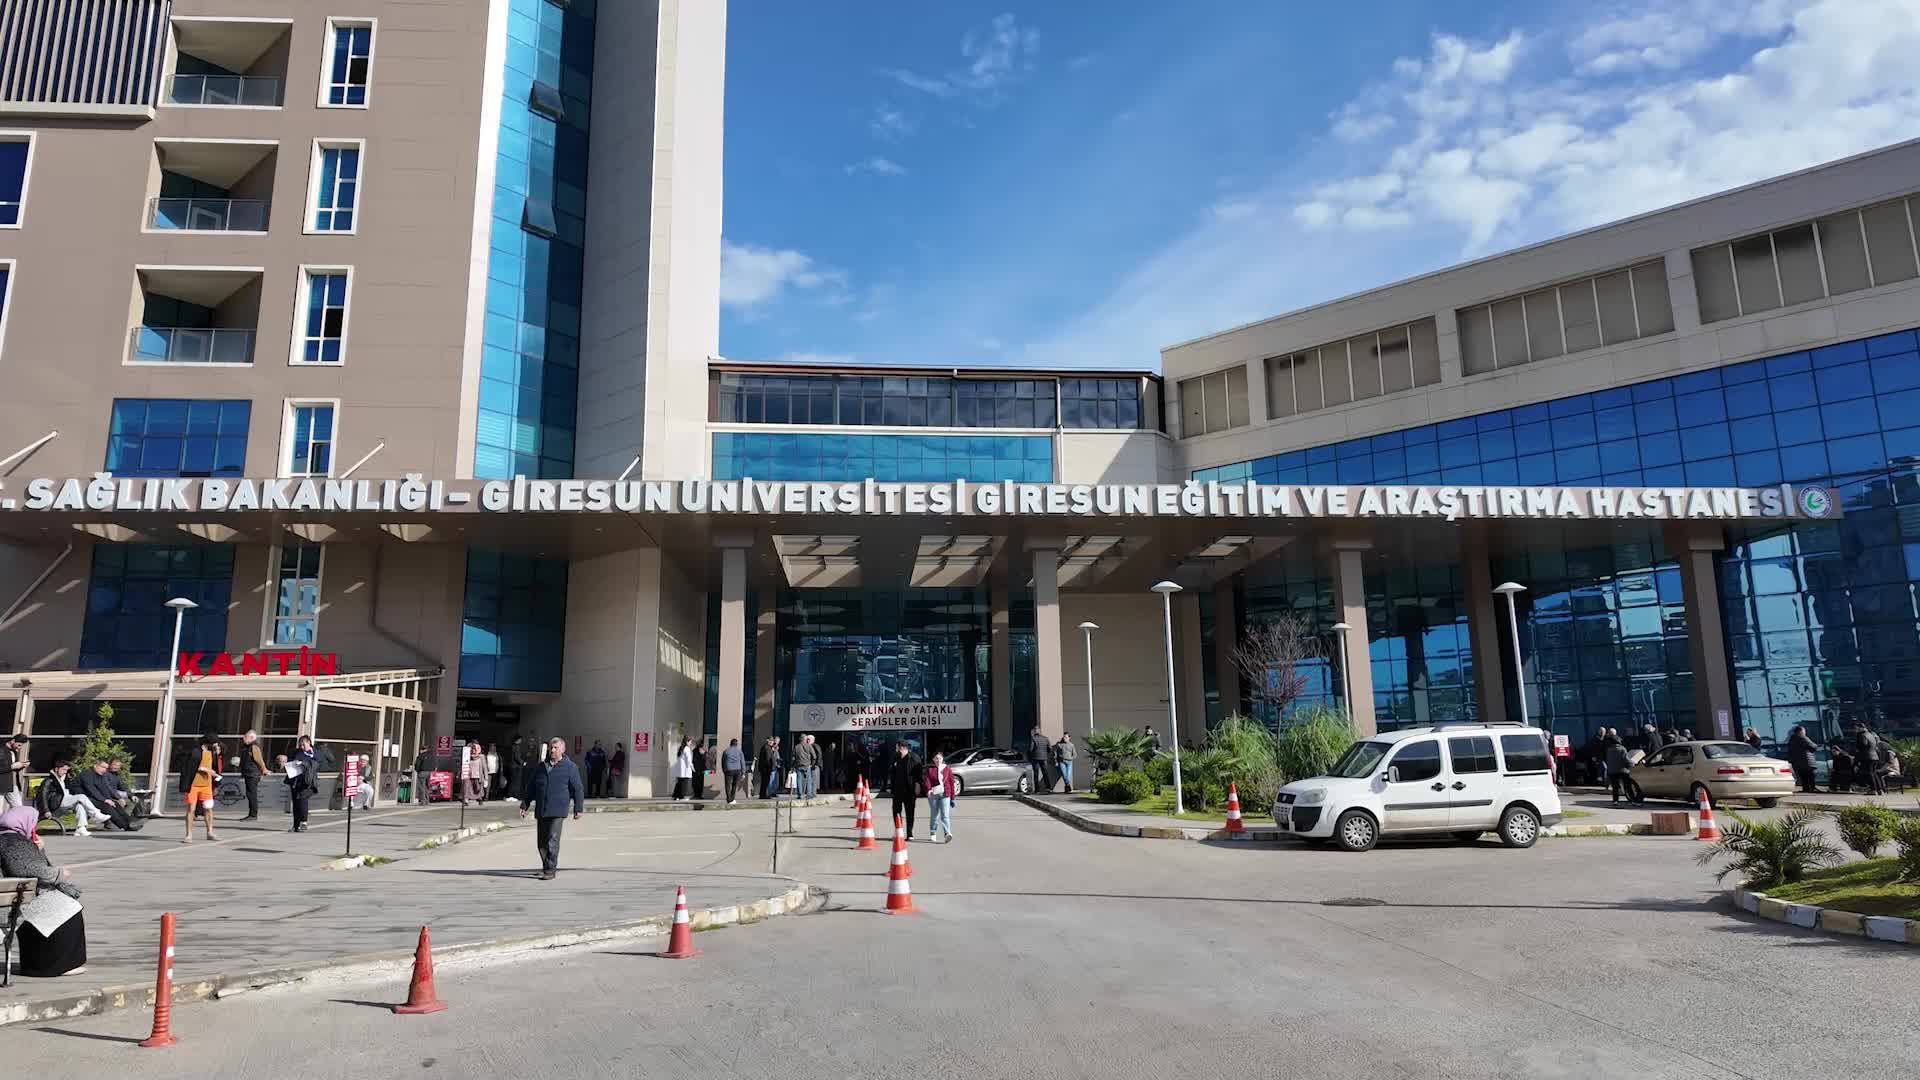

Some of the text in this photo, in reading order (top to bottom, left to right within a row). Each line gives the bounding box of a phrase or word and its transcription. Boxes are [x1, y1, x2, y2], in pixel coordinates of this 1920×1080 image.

[25, 472, 193, 510] SAĞLIK
[200, 474, 442, 510] BAKANLIĞI
[482, 474, 671, 511] GİRESUN
[977, 479, 1148, 514] GİRESUN
[1157, 479, 1290, 514] EĞİTİM
[1300, 487, 1347, 514] VE
[1359, 487, 1583, 520] ARAŞTIRMA
[1593, 483, 1794, 517] HASTANESİ
[178, 645, 337, 676] KANTİN
[836, 704, 957, 715] POLİKLİNİK ve YATAKLI
[851, 716, 941, 727] SERVİSLER GİRİŞİ
